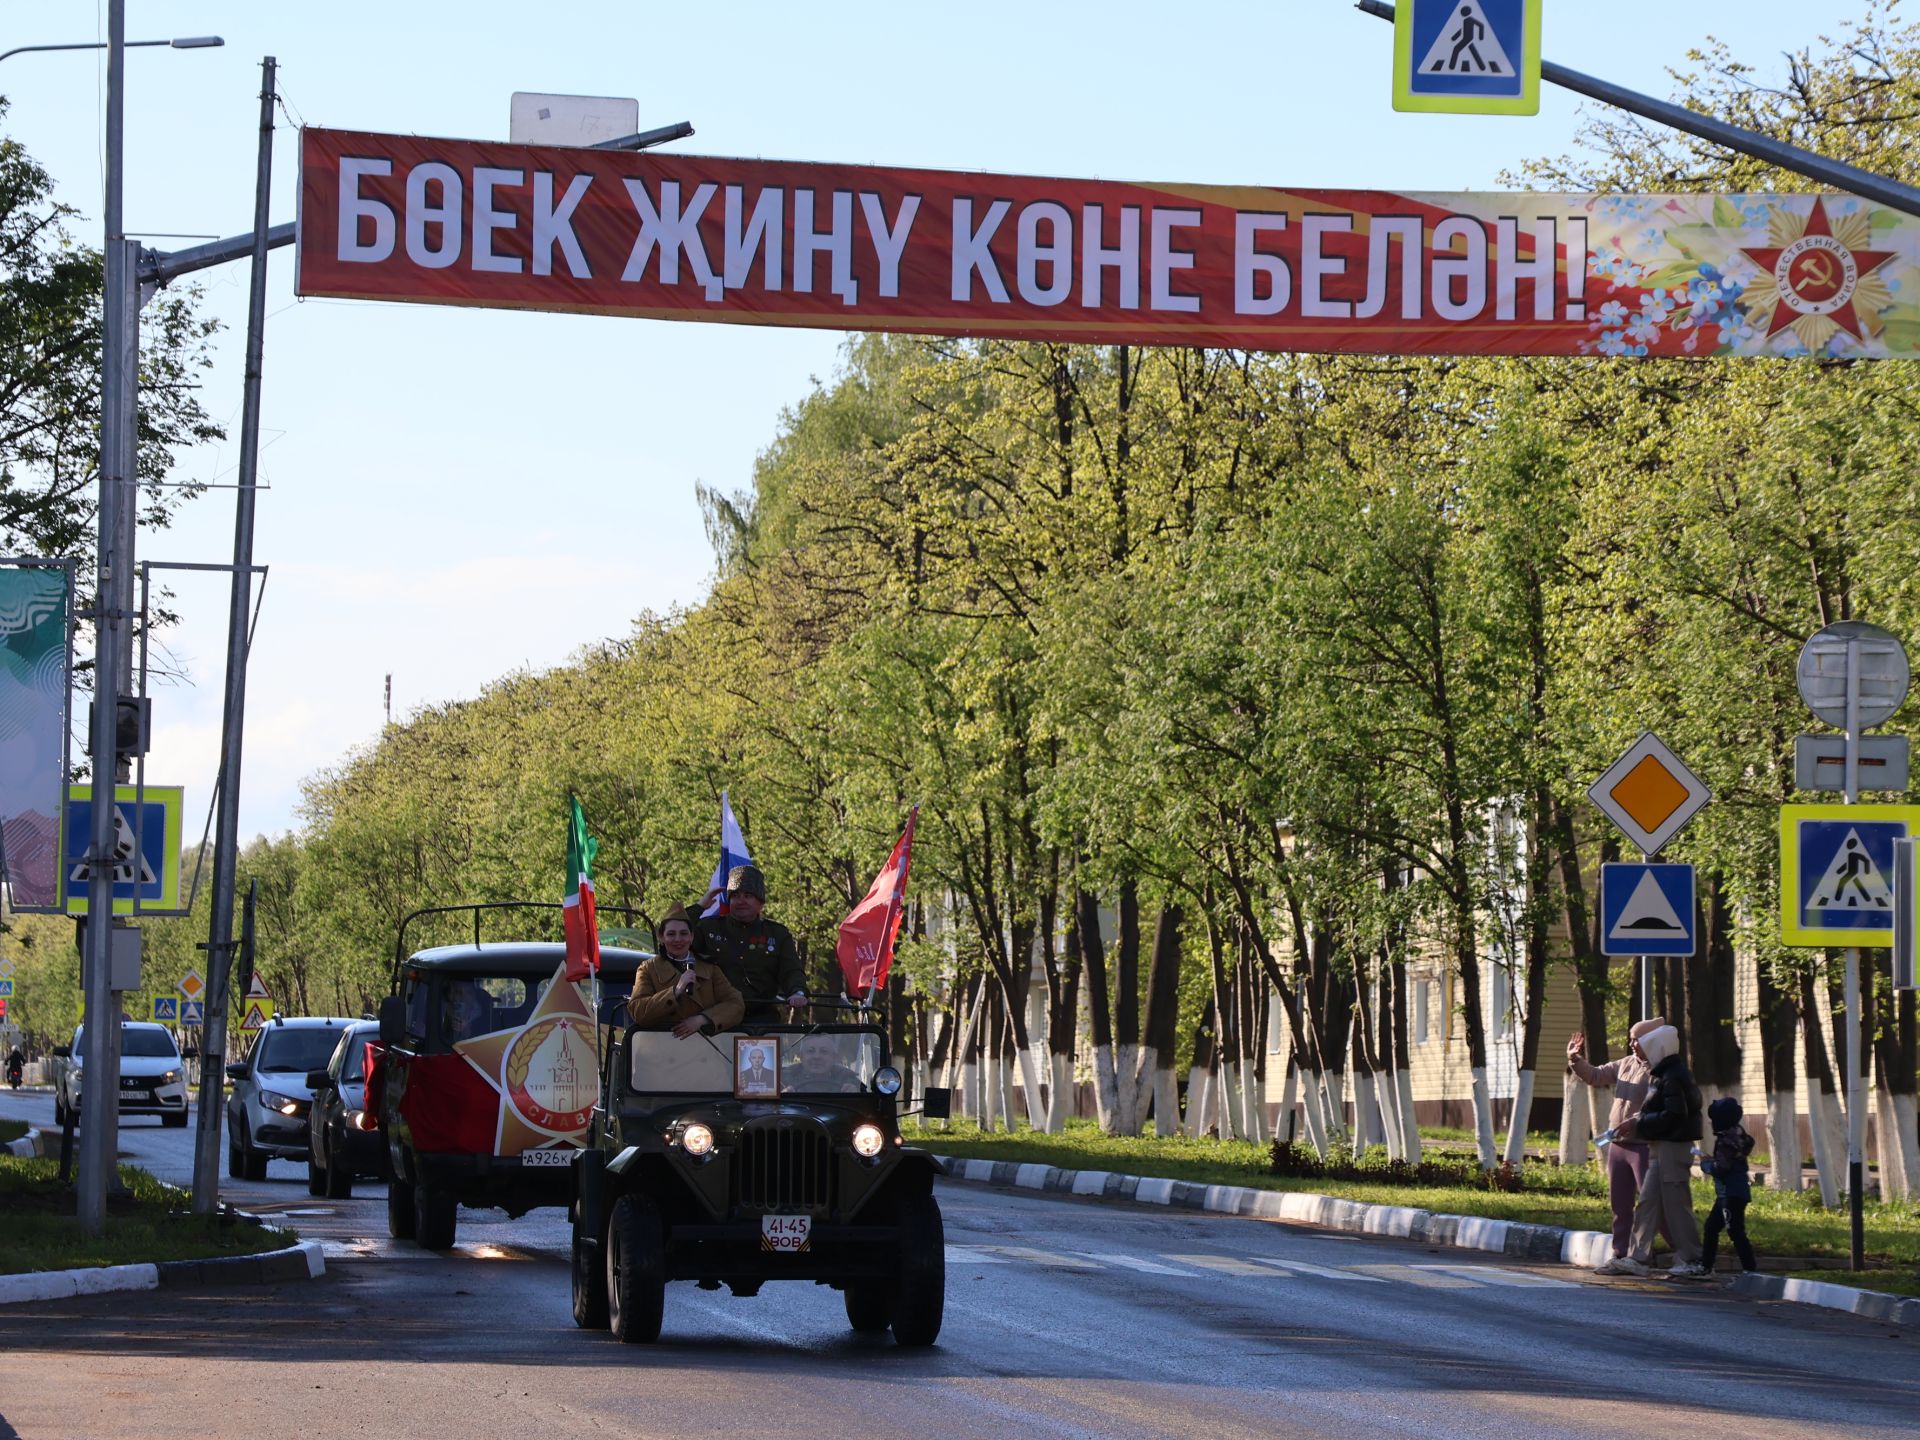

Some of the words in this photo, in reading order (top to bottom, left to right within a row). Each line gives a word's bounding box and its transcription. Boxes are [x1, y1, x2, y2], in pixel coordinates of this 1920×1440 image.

[337, 156, 593, 279] БӨЕК
[951, 196, 1202, 313] КӨНЕ
[1233, 210, 1588, 322] БЕЛӘН!
[1778, 238, 1849, 307] ОТЕЧЕСТВЕННАЯ
[528, 1104, 594, 1128] СЛАВ
[526, 1151, 572, 1165] А926К
[769, 1218, 807, 1234] 41-45
